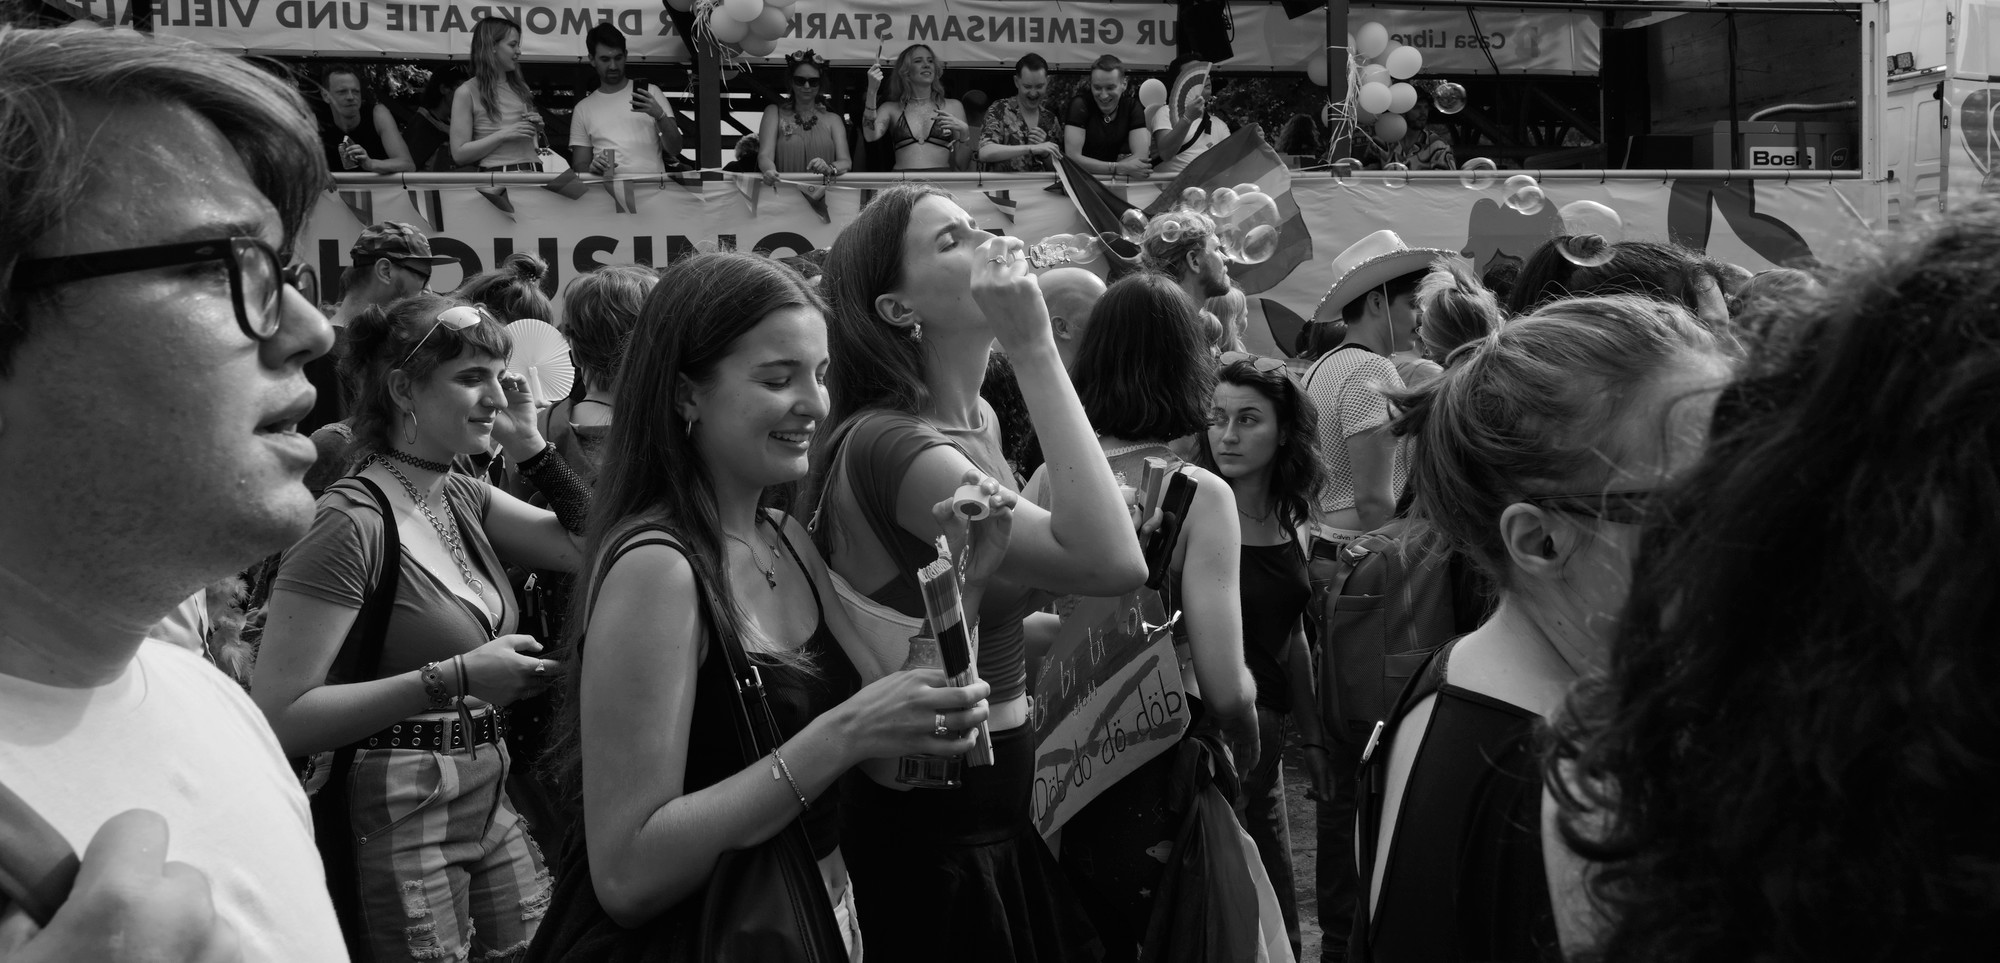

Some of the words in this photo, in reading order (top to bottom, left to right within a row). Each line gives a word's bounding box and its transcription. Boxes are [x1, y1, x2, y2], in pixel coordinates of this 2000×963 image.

[1332, 532, 1351, 541] Calvin
[1059, 656, 1076, 699] bi
[1086, 626, 1106, 666] bi
[1034, 765, 1067, 821] Döb
[1101, 718, 1126, 765] dö
[1136, 669, 1182, 736] döb
